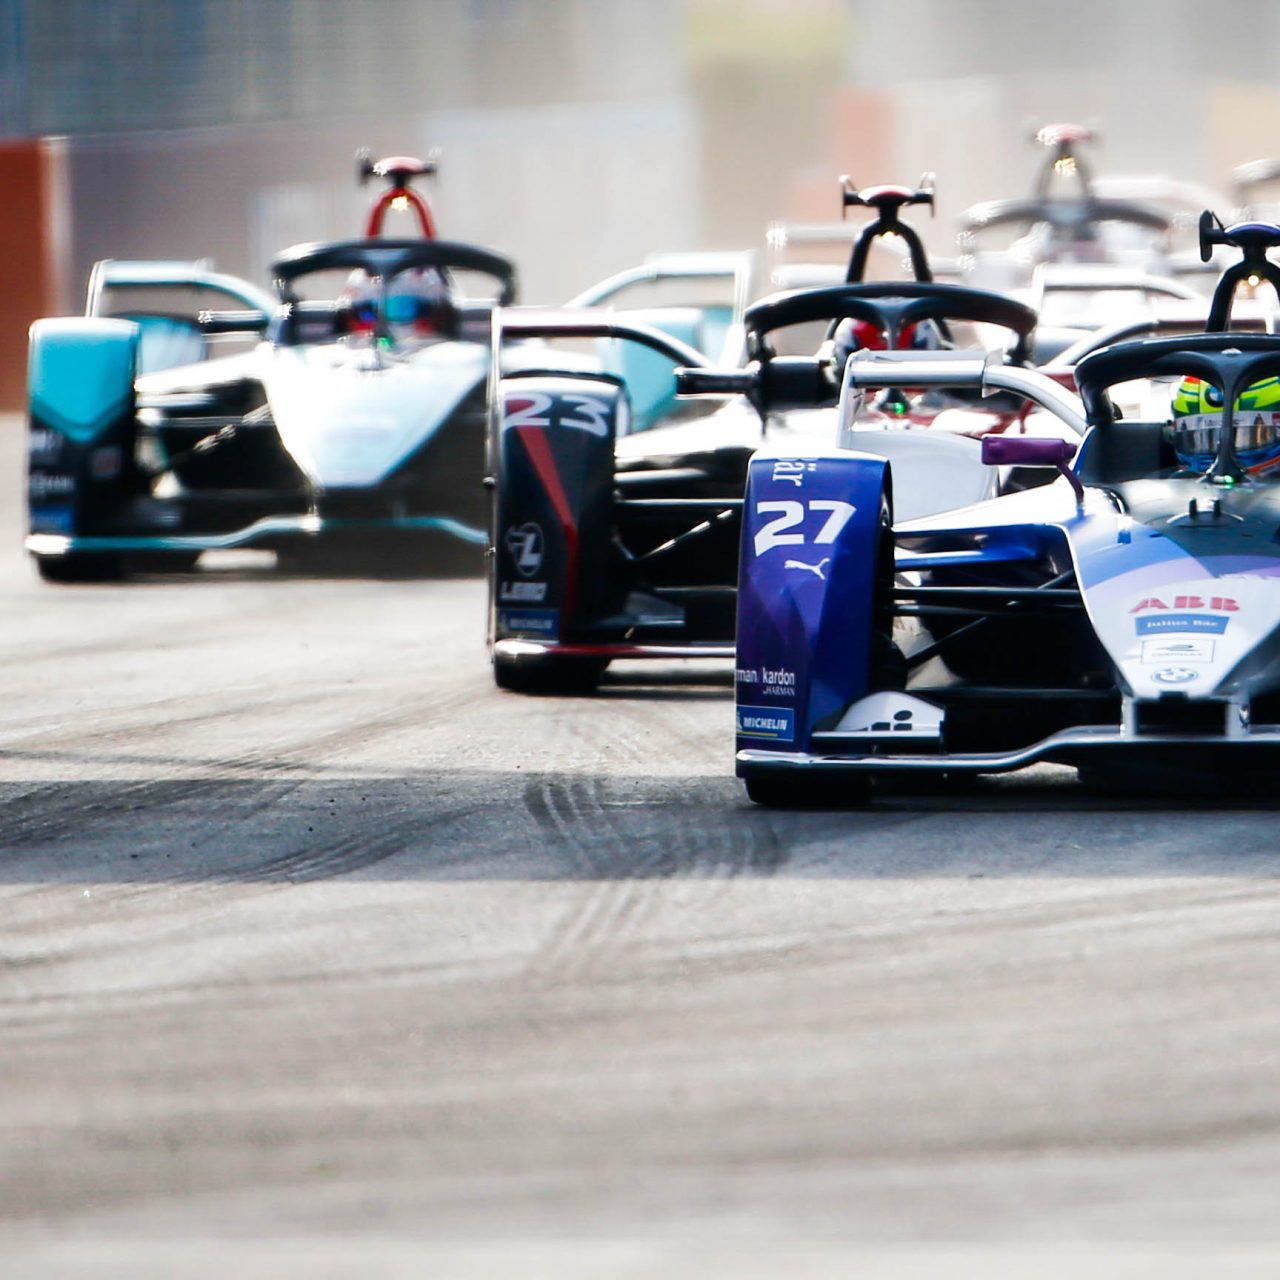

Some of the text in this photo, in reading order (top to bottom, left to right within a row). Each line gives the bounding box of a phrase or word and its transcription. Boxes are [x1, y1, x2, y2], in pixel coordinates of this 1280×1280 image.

[503, 392, 610, 437] 23
[754, 500, 857, 557] 27
[1129, 596, 1240, 613] ABB
[743, 716, 788, 731] MICHELIN
